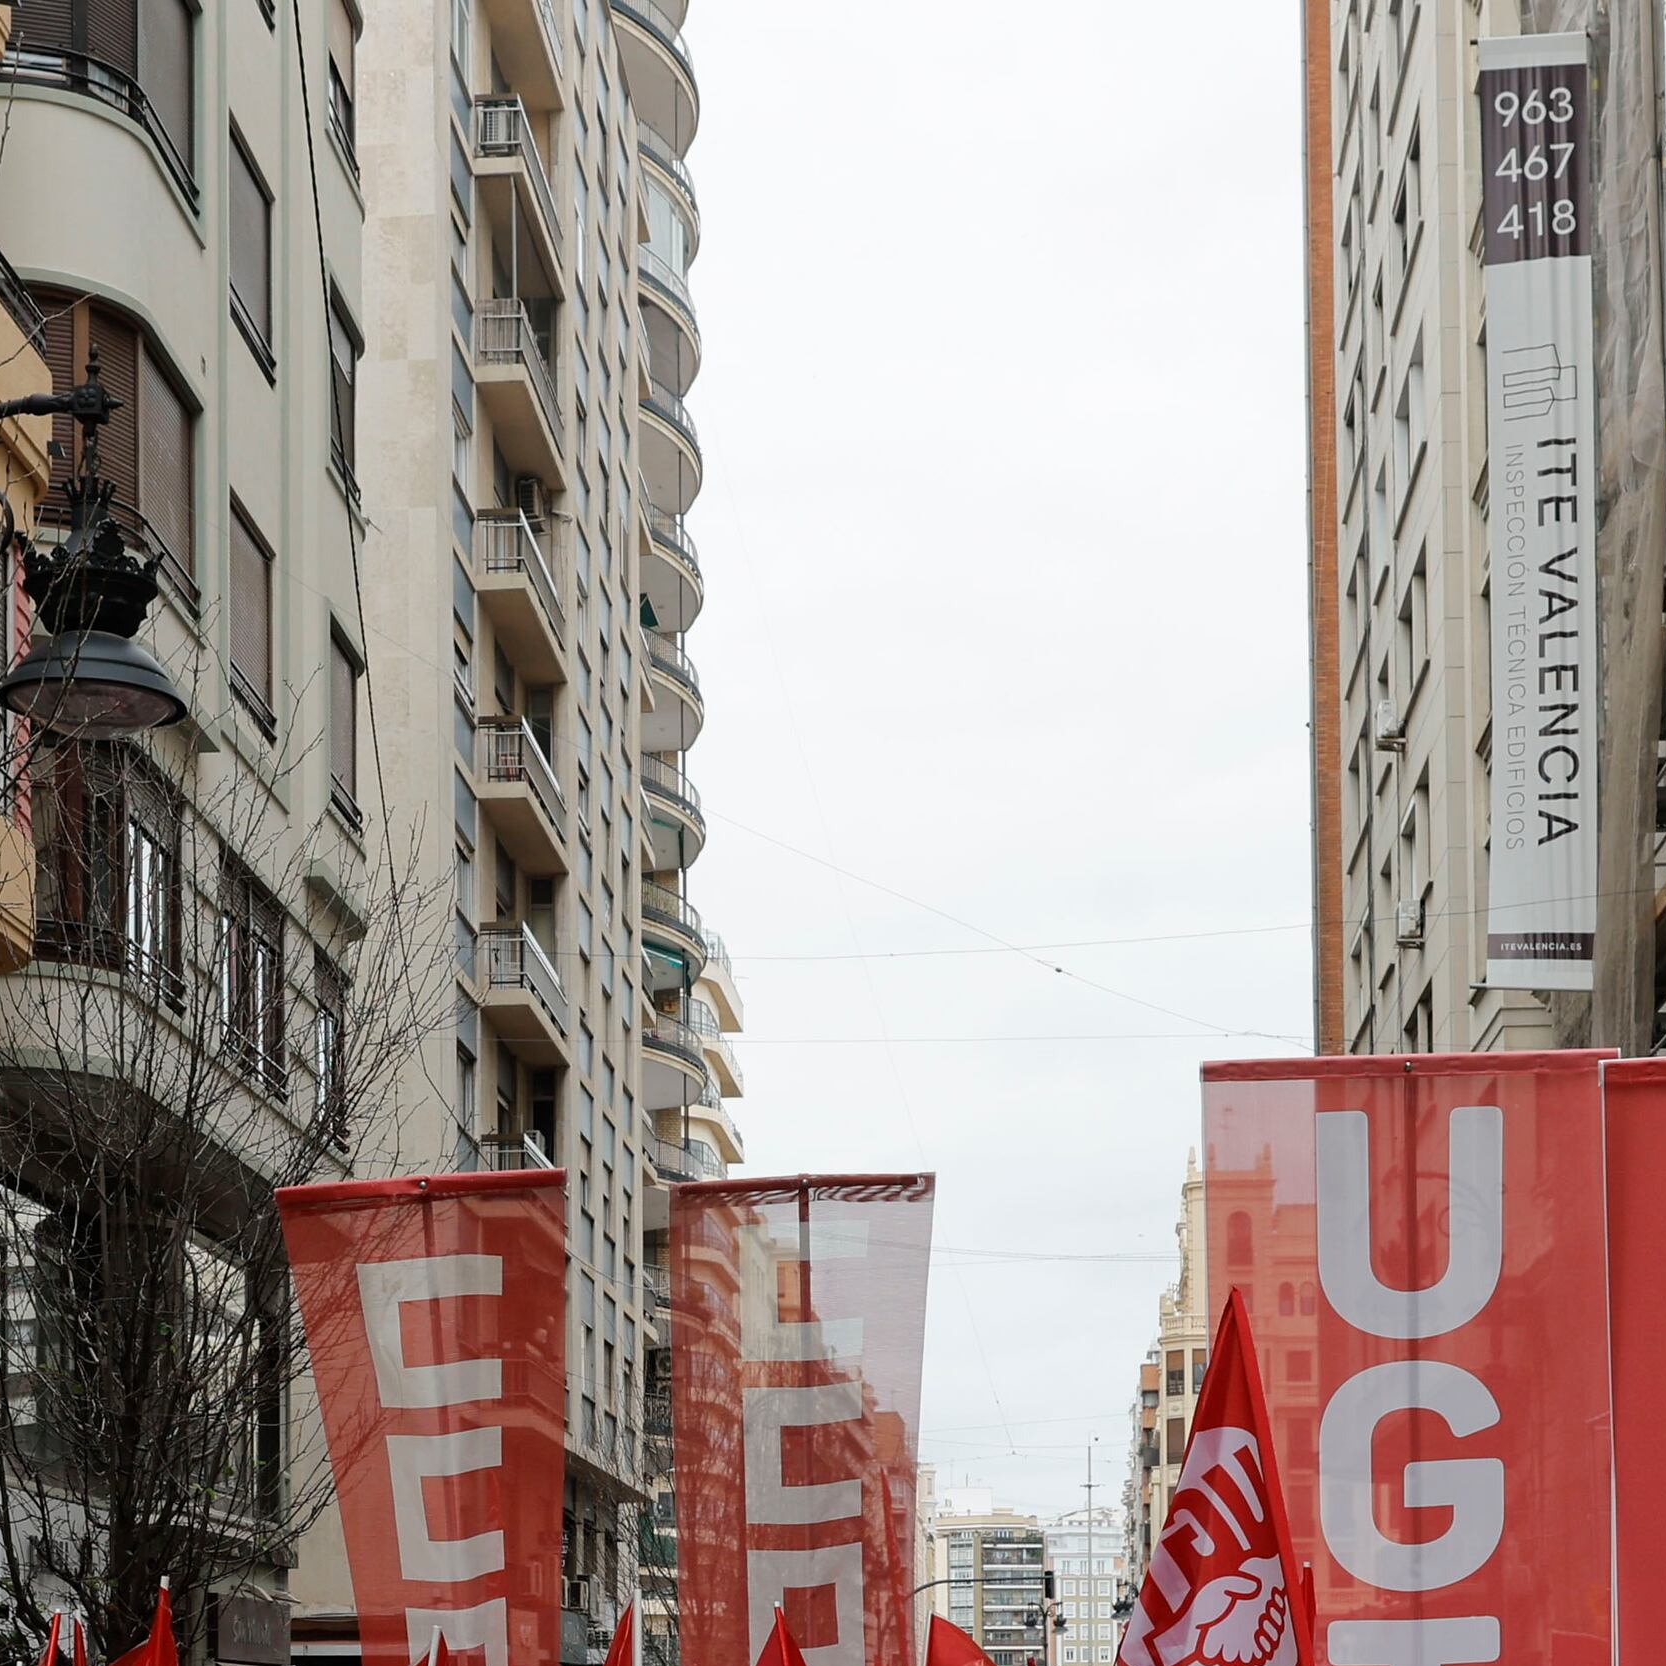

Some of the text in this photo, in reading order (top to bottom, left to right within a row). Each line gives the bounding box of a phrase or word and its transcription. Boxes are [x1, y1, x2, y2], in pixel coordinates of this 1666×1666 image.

[1494, 87, 1574, 127] 963
[1494, 142, 1575, 183] 467
[1496, 198, 1577, 240] 418
[1505, 443, 1525, 850] INSPECCIÓN TÉCNICA EDIFICIOS
[1537, 437, 1580, 848] ITE VALENCIA
[1501, 941, 1583, 952] ITEVALENCIA.ES
